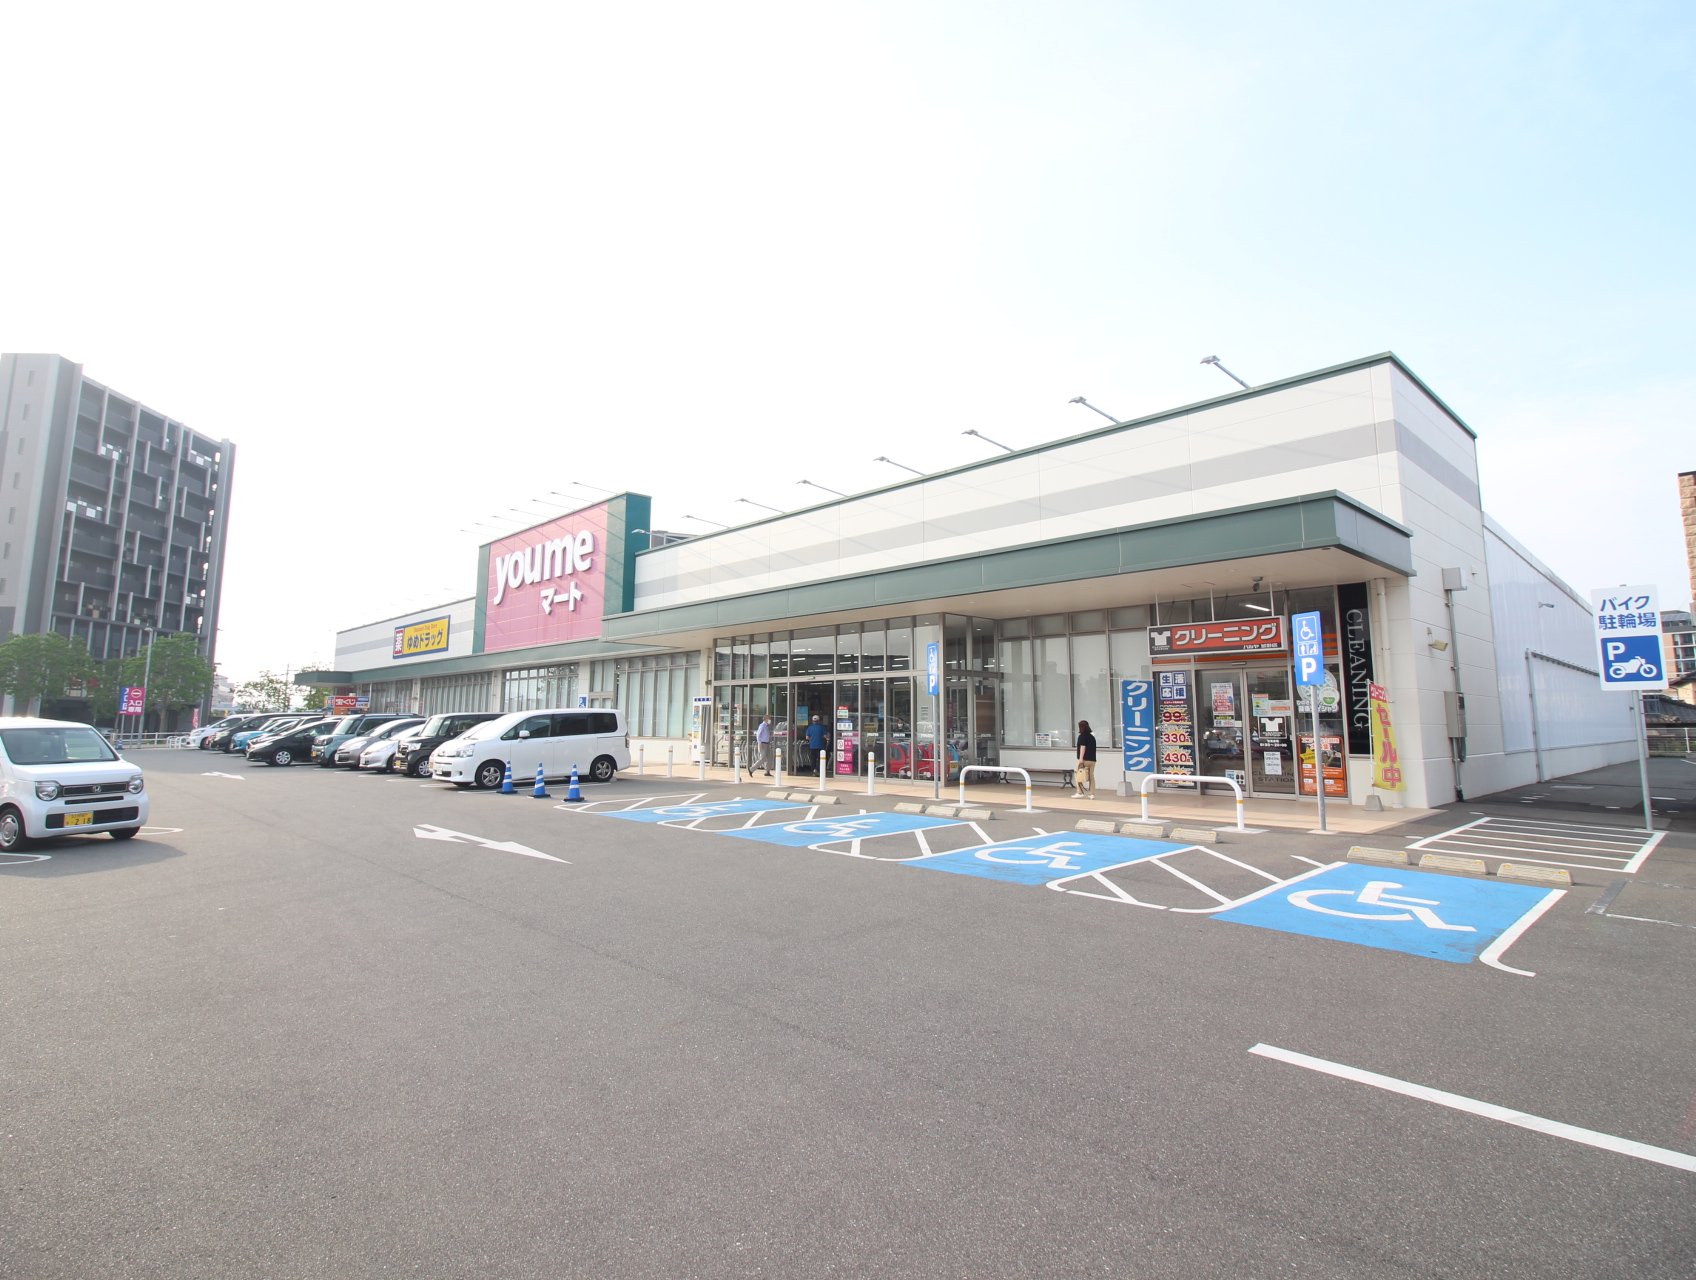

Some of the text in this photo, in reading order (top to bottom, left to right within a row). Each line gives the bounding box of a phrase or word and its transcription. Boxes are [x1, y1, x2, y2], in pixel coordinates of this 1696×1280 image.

[493, 529, 594, 606] youme
[540, 581, 583, 615] マート
[1600, 595, 1650, 612] バイク
[1598, 612, 1657, 630] 駐輪場
[406, 628, 443, 650] ゆめドラッグ
[1174, 622, 1278, 646] クリーニング
[1606, 641, 1626, 661] P
[1301, 657, 1316, 682] P
[1346, 608, 1369, 729] CLEANING
[929, 674, 936, 693] P
[1126, 681, 1152, 771] クリーニング
[1376, 702, 1402, 788] セール中
